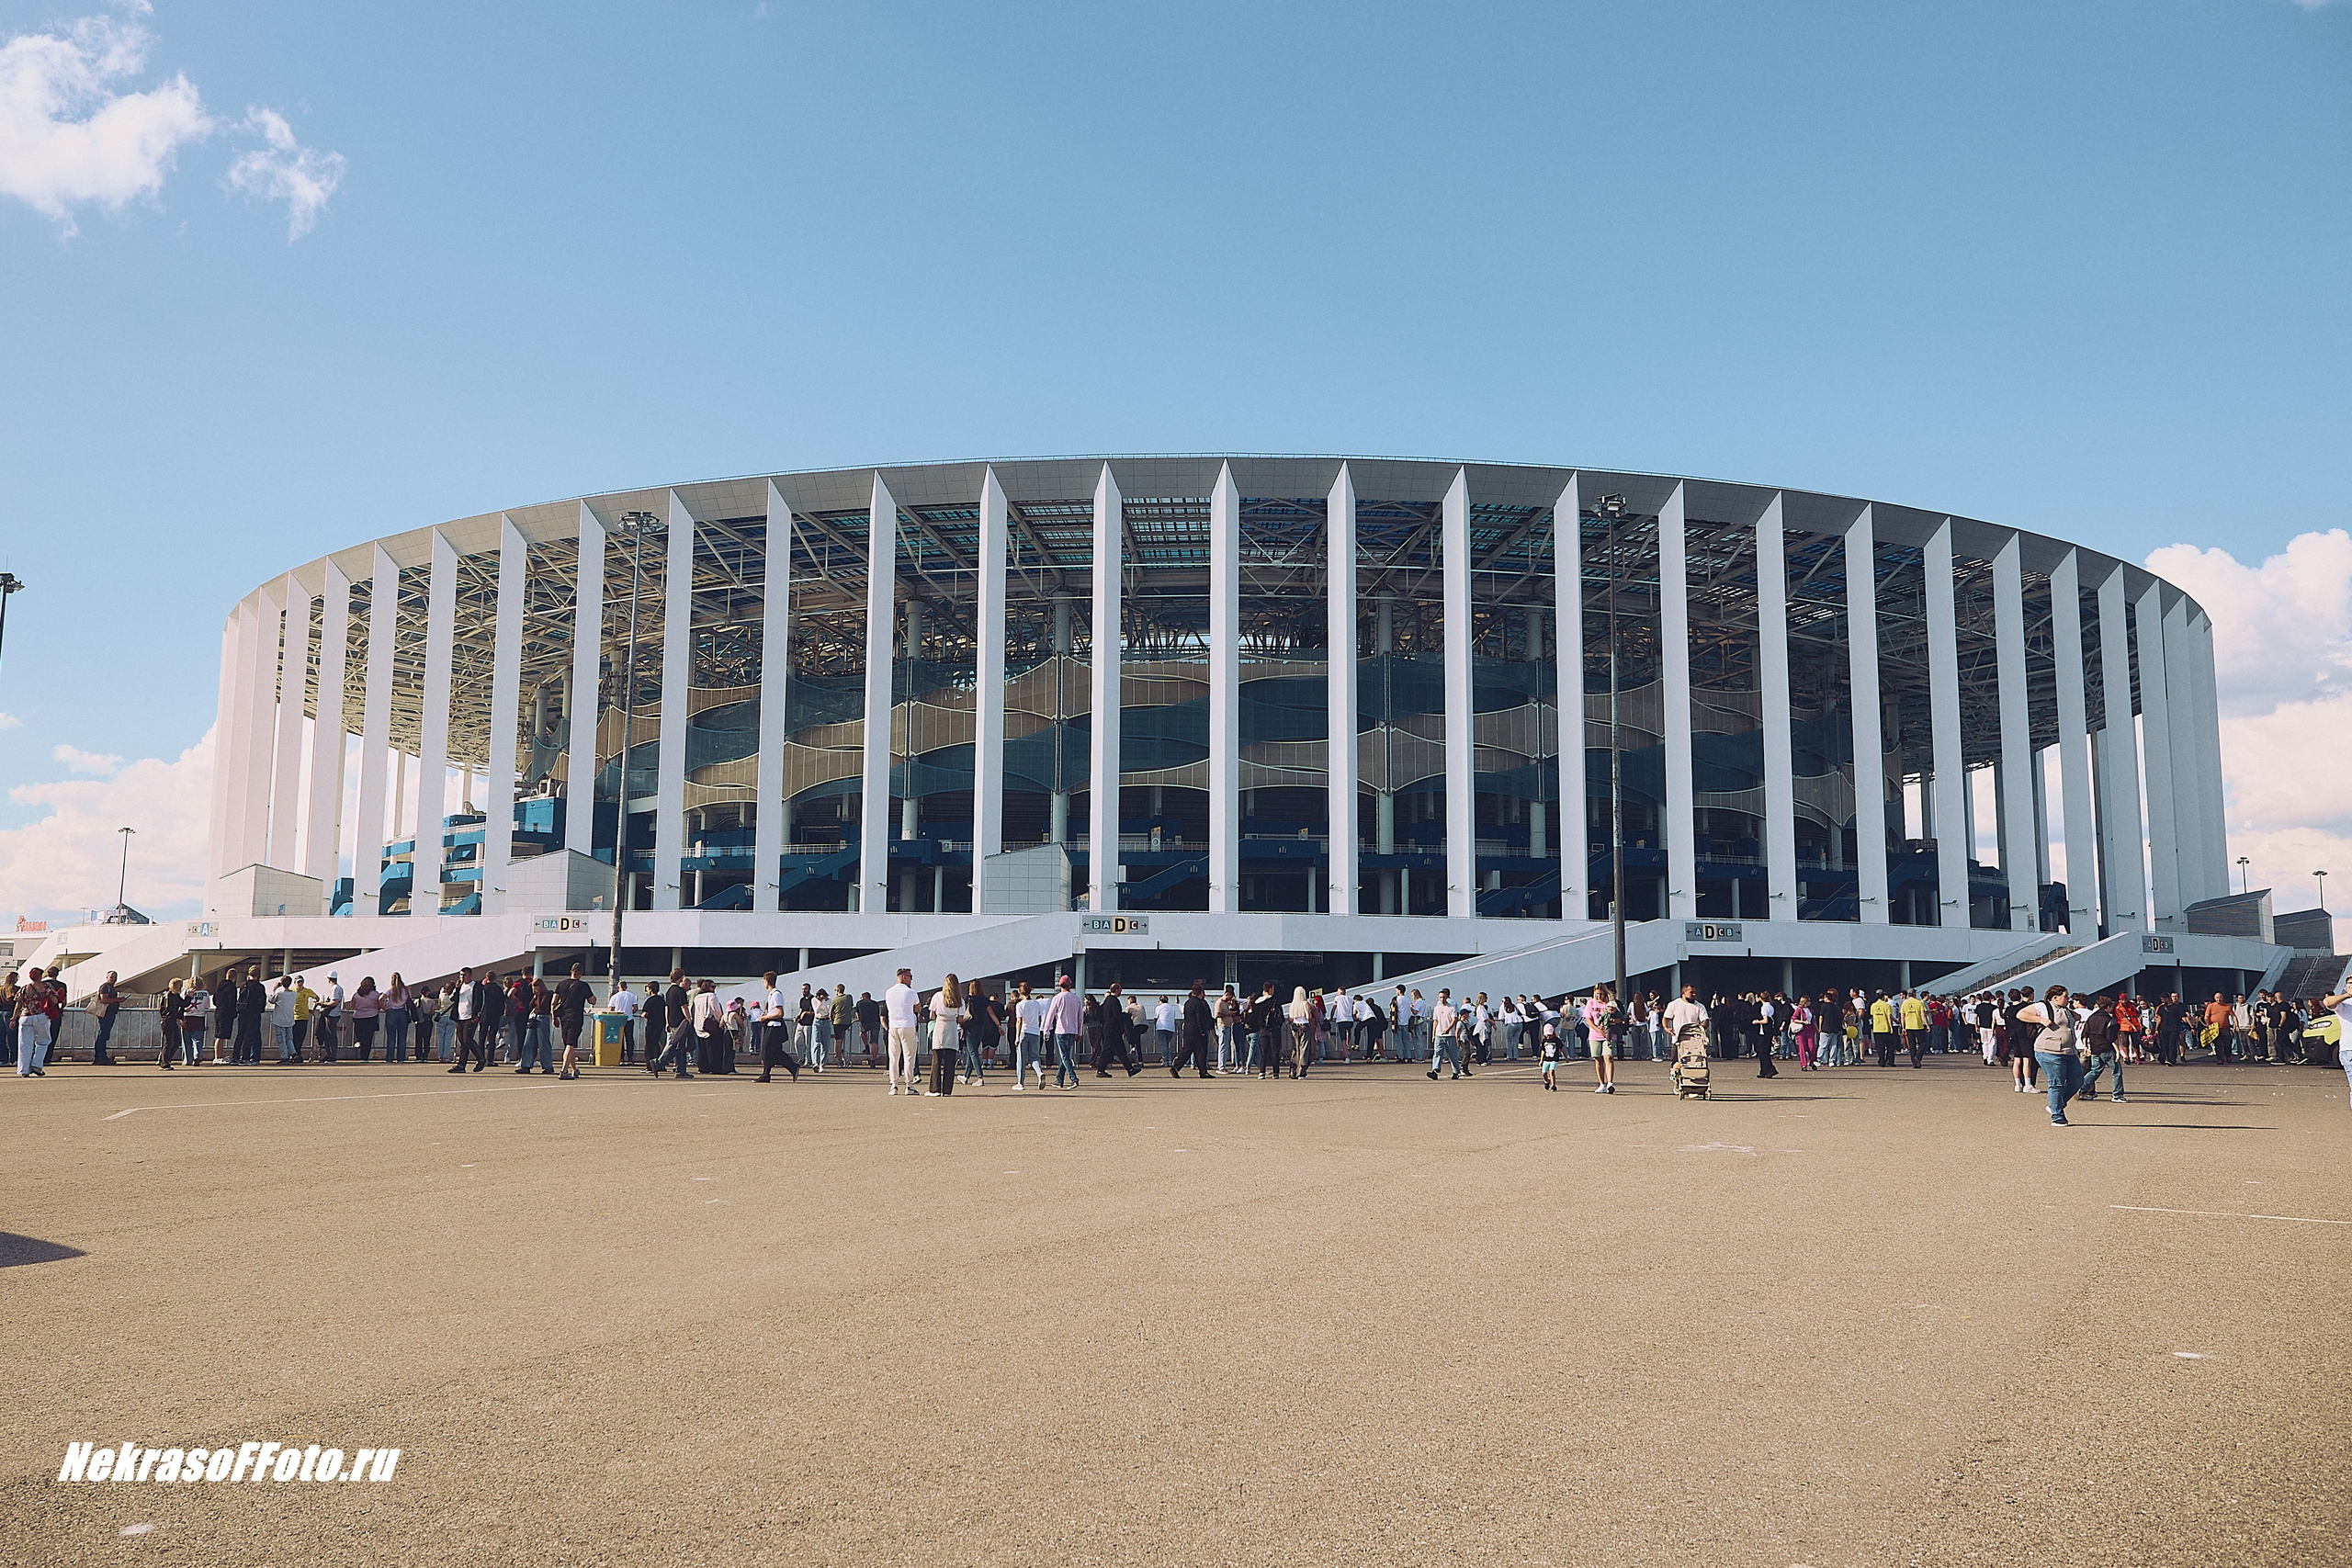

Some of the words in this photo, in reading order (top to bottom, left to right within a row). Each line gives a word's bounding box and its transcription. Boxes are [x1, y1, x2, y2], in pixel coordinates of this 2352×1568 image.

[202, 923, 209, 935] A
[560, 918, 570, 930] D
[1093, 920, 1100, 929] B
[1102, 920, 1110, 929] A
[1114, 918, 1126, 932] D
[1695, 928, 1702, 936] A
[1705, 925, 1715, 939] D
[2153, 938, 2159, 951] D
